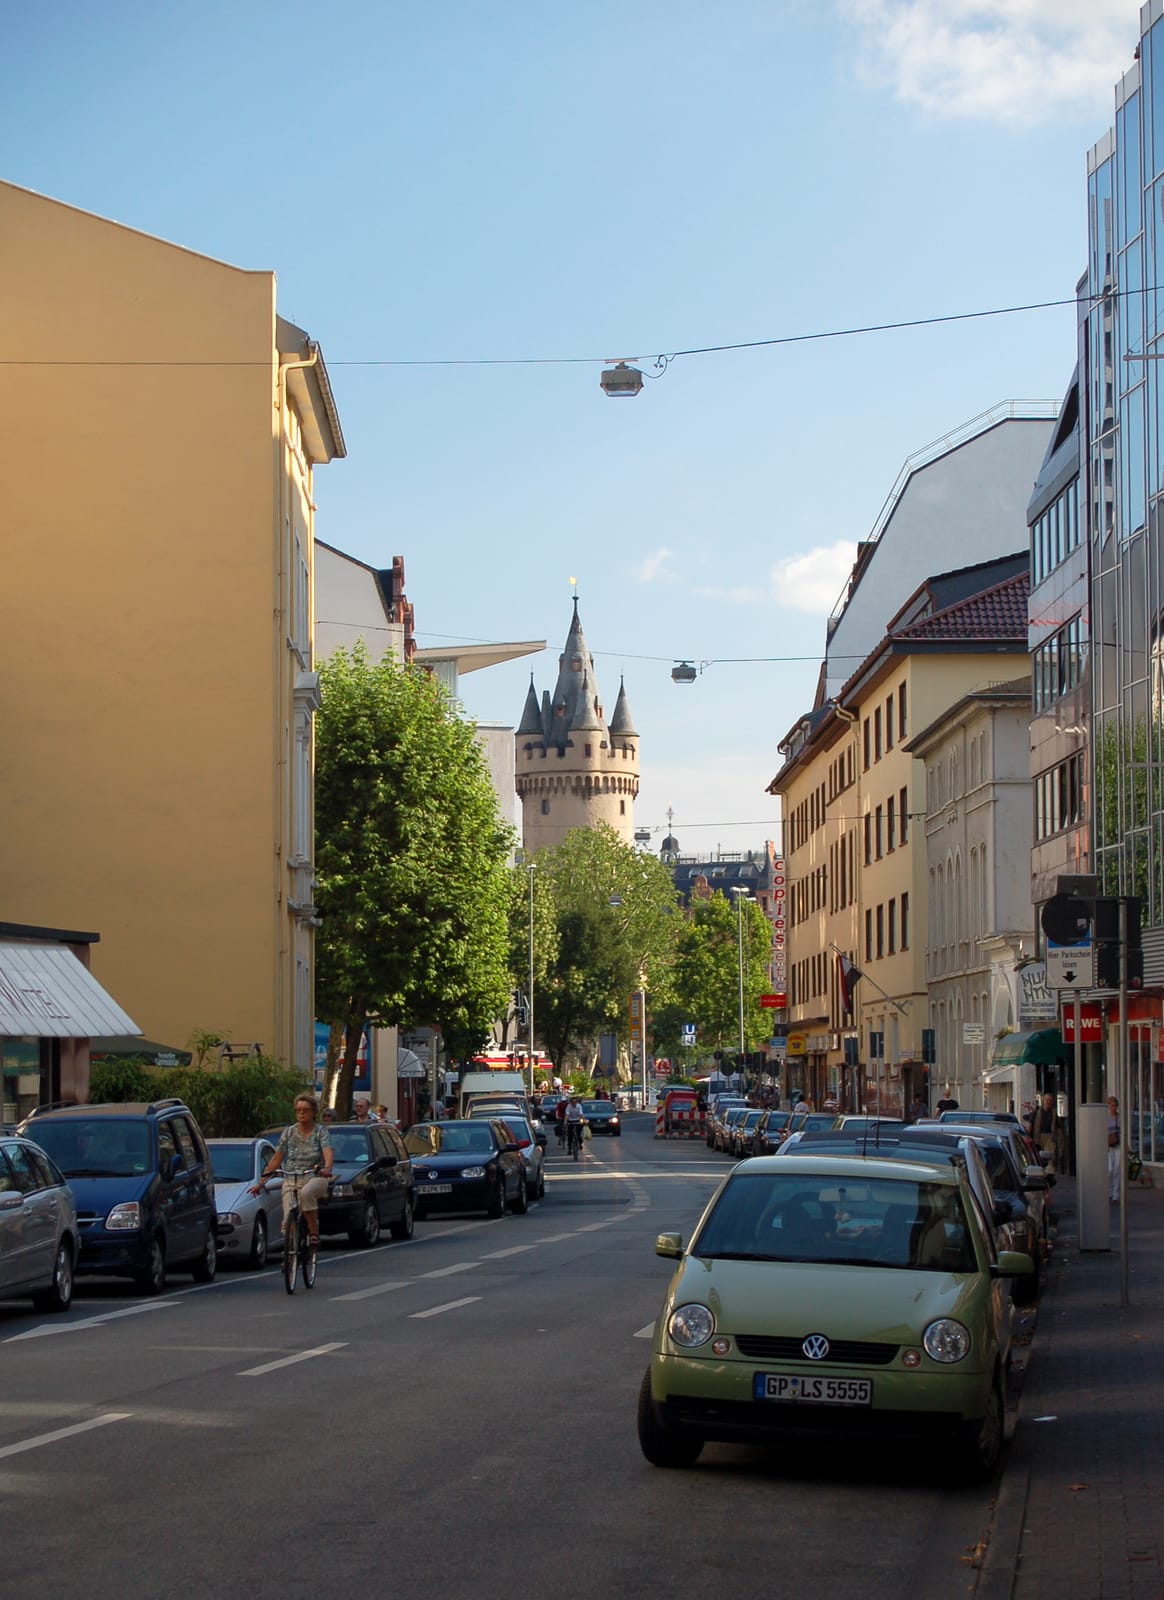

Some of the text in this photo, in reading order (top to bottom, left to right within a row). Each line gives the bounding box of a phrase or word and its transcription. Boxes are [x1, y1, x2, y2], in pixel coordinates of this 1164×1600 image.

[773, 861, 785, 943] copies
[1066, 1018, 1100, 1029] RWE
[766, 1377, 868, 1401] GP LS 5555
